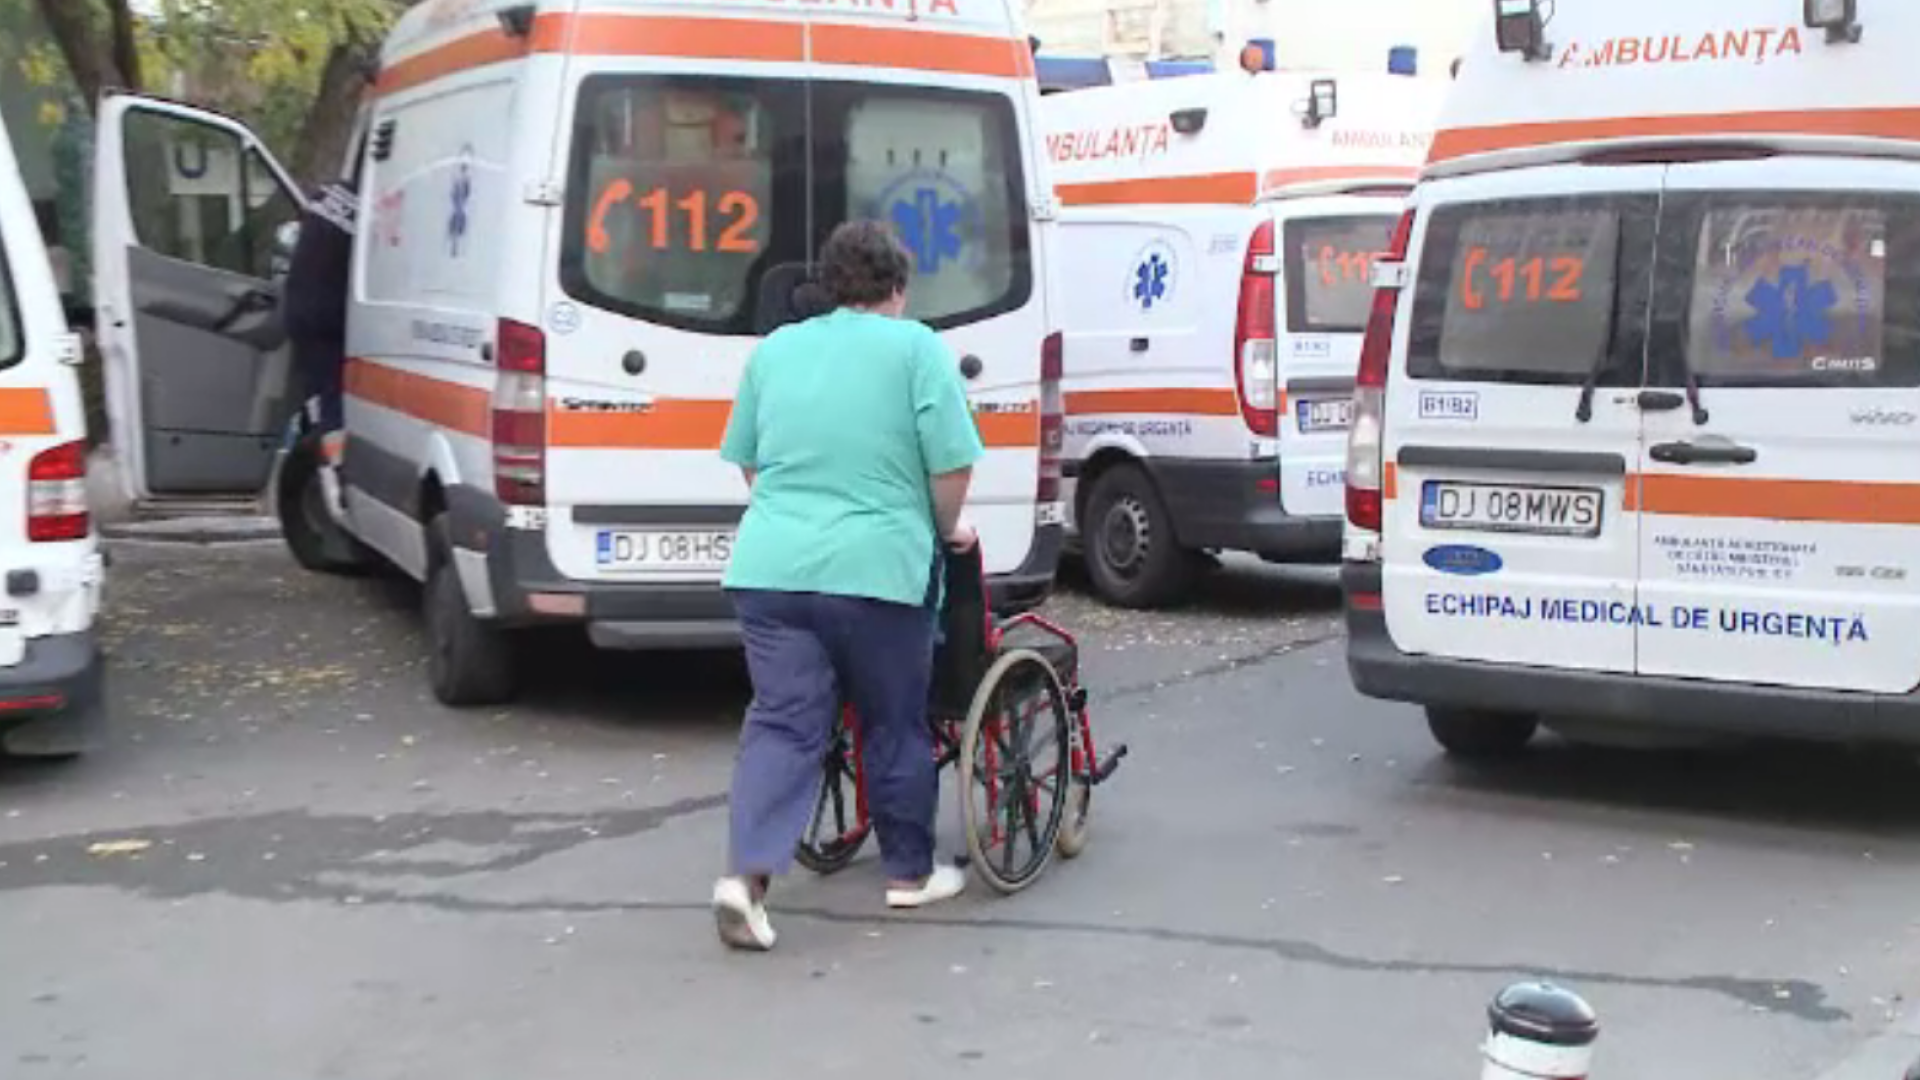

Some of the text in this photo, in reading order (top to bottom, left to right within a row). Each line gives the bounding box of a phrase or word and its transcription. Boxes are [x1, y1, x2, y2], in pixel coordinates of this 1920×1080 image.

[1046, 122, 1168, 163] MBULANȚA
[640, 187, 759, 254] 112
[1489, 254, 1584, 303] 112
[1439, 488, 1476, 518] DJ
[615, 534, 735, 561] DJ 08HS
[1426, 593, 1531, 619] ECHIPAJ
[1540, 599, 1662, 627] MEDICAL
[1673, 605, 1709, 631] DE
